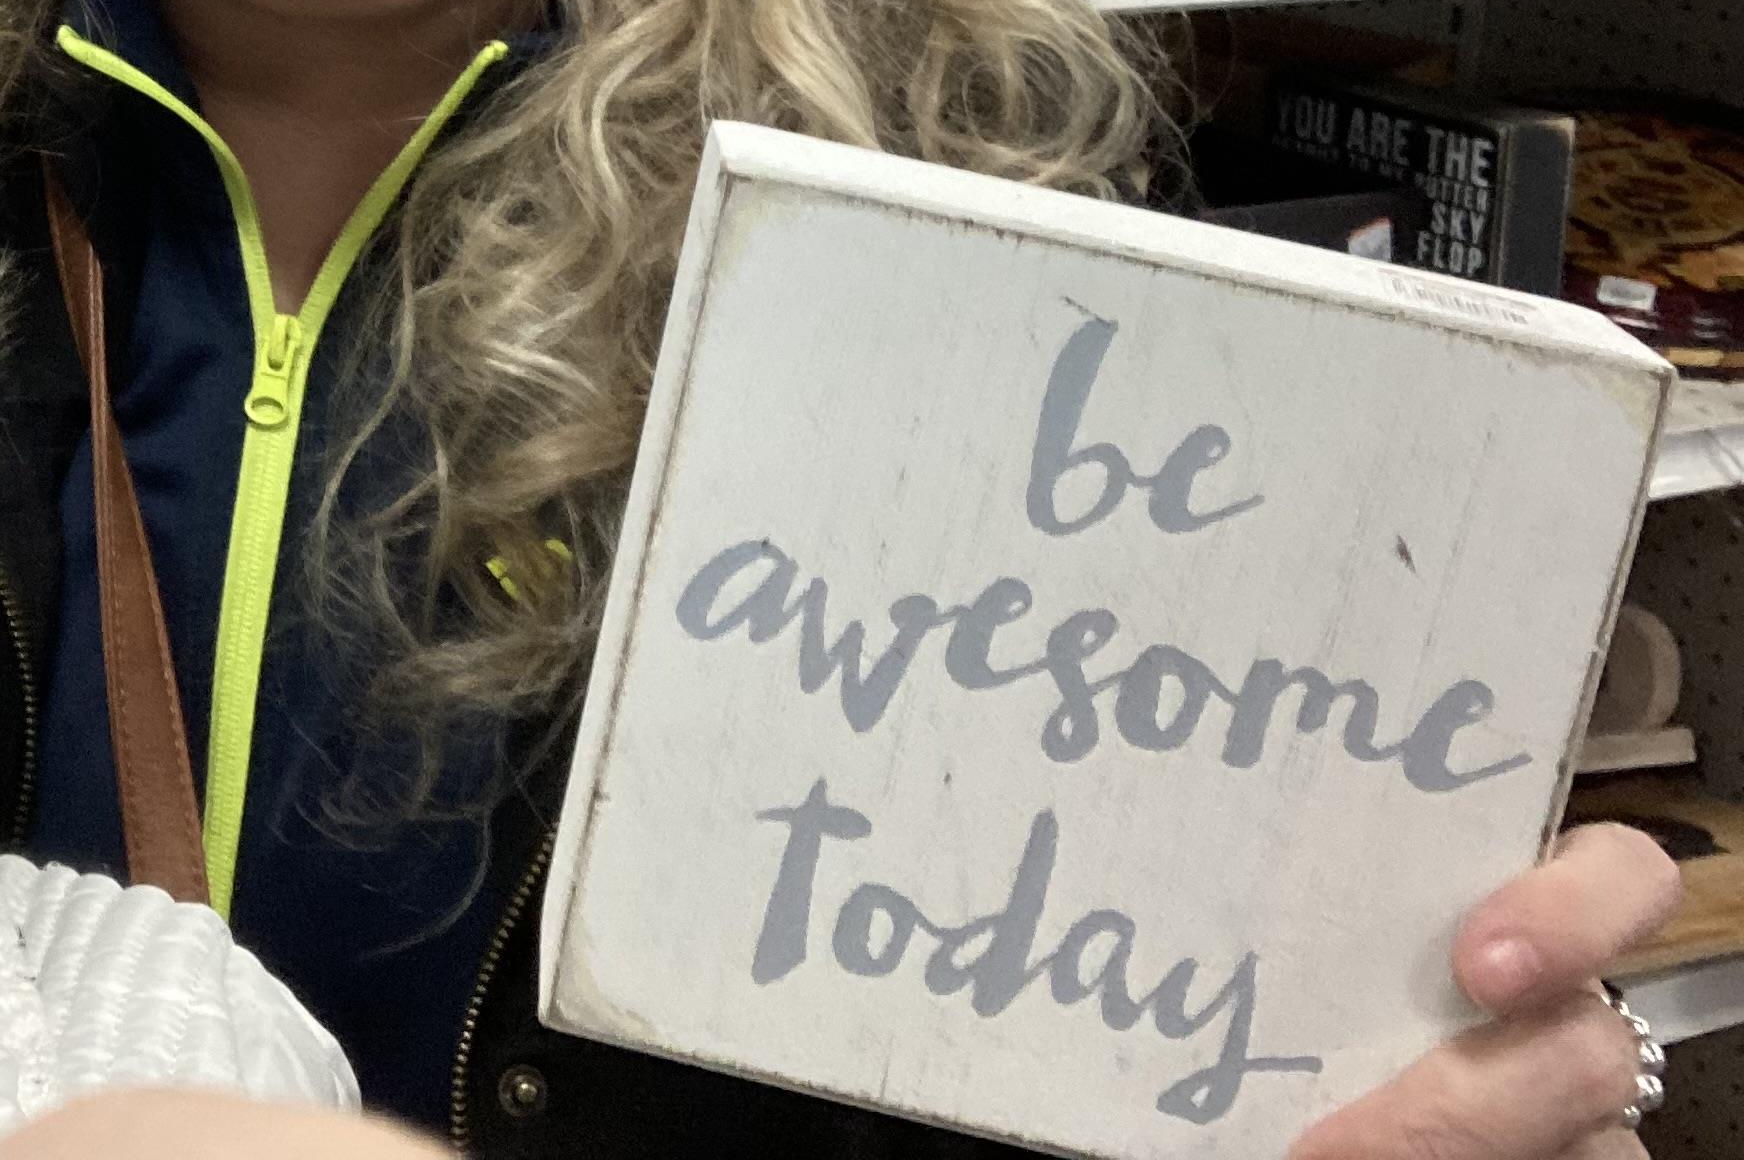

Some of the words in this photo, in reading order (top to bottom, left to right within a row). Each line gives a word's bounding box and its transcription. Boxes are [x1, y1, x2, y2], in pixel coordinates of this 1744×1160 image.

[1276, 92, 1338, 146] YOU
[1345, 105, 1414, 168] ARE
[1425, 126, 1496, 188] THE
[1416, 229, 1485, 278] FLOP
[1431, 200, 1487, 246] SKY
[1026, 319, 1265, 537] be
[675, 539, 1534, 794] awesome
[750, 776, 1324, 1126] today
